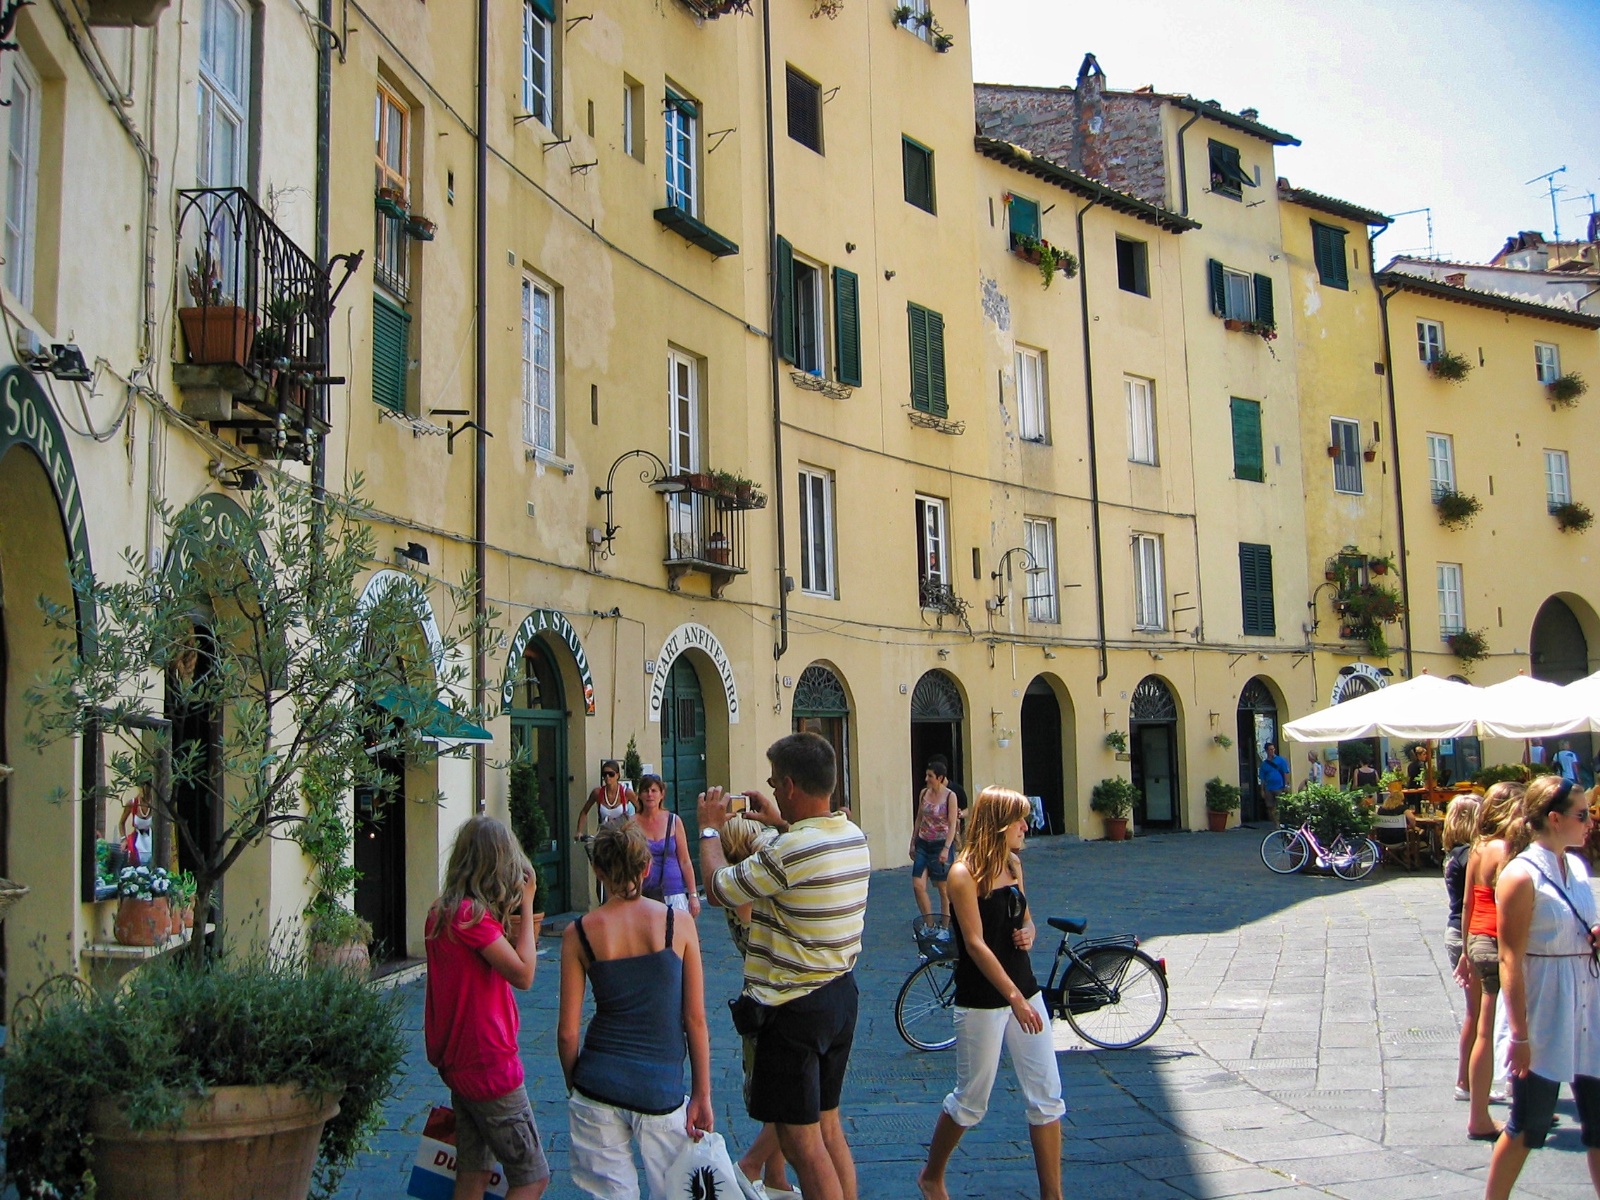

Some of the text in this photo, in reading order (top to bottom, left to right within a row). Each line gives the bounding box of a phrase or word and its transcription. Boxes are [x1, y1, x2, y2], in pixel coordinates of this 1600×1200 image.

[7, 374, 84, 566] SORELL
[651, 626, 738, 714] OTTART ANFITEATRO
